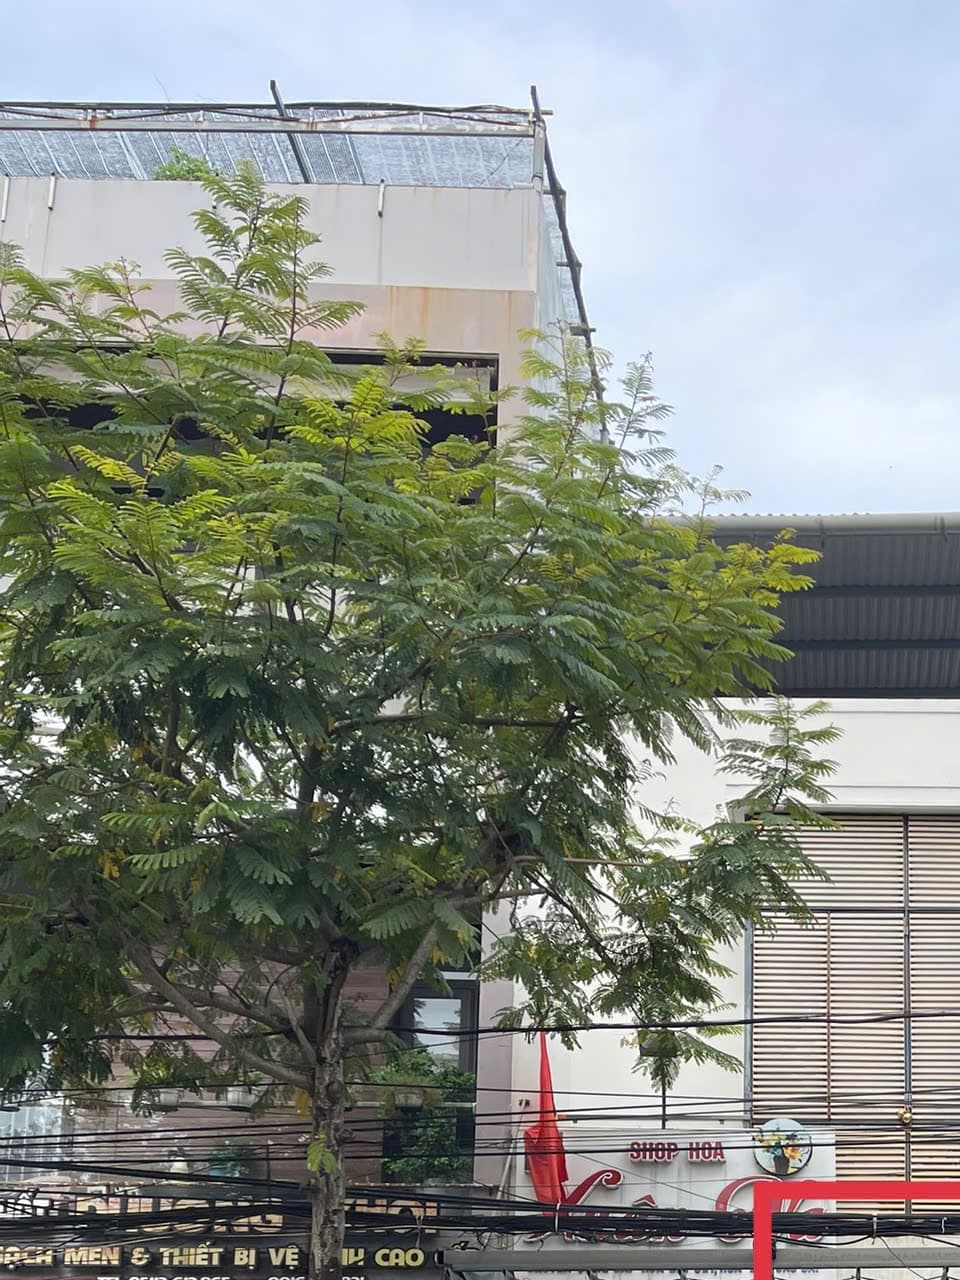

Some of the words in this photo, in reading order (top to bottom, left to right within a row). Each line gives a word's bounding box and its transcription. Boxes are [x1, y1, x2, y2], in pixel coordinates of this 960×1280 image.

[630, 1141, 678, 1163] SHOP
[688, 1141, 727, 1163] HOA
[64, 1247, 120, 1265] MEN
[130, 1247, 152, 1266] &
[159, 1241, 224, 1266] THIẾT
[233, 1247, 257, 1270] BỊ
[268, 1245, 300, 1270] VỆ
[375, 1248, 425, 1267] CAO
